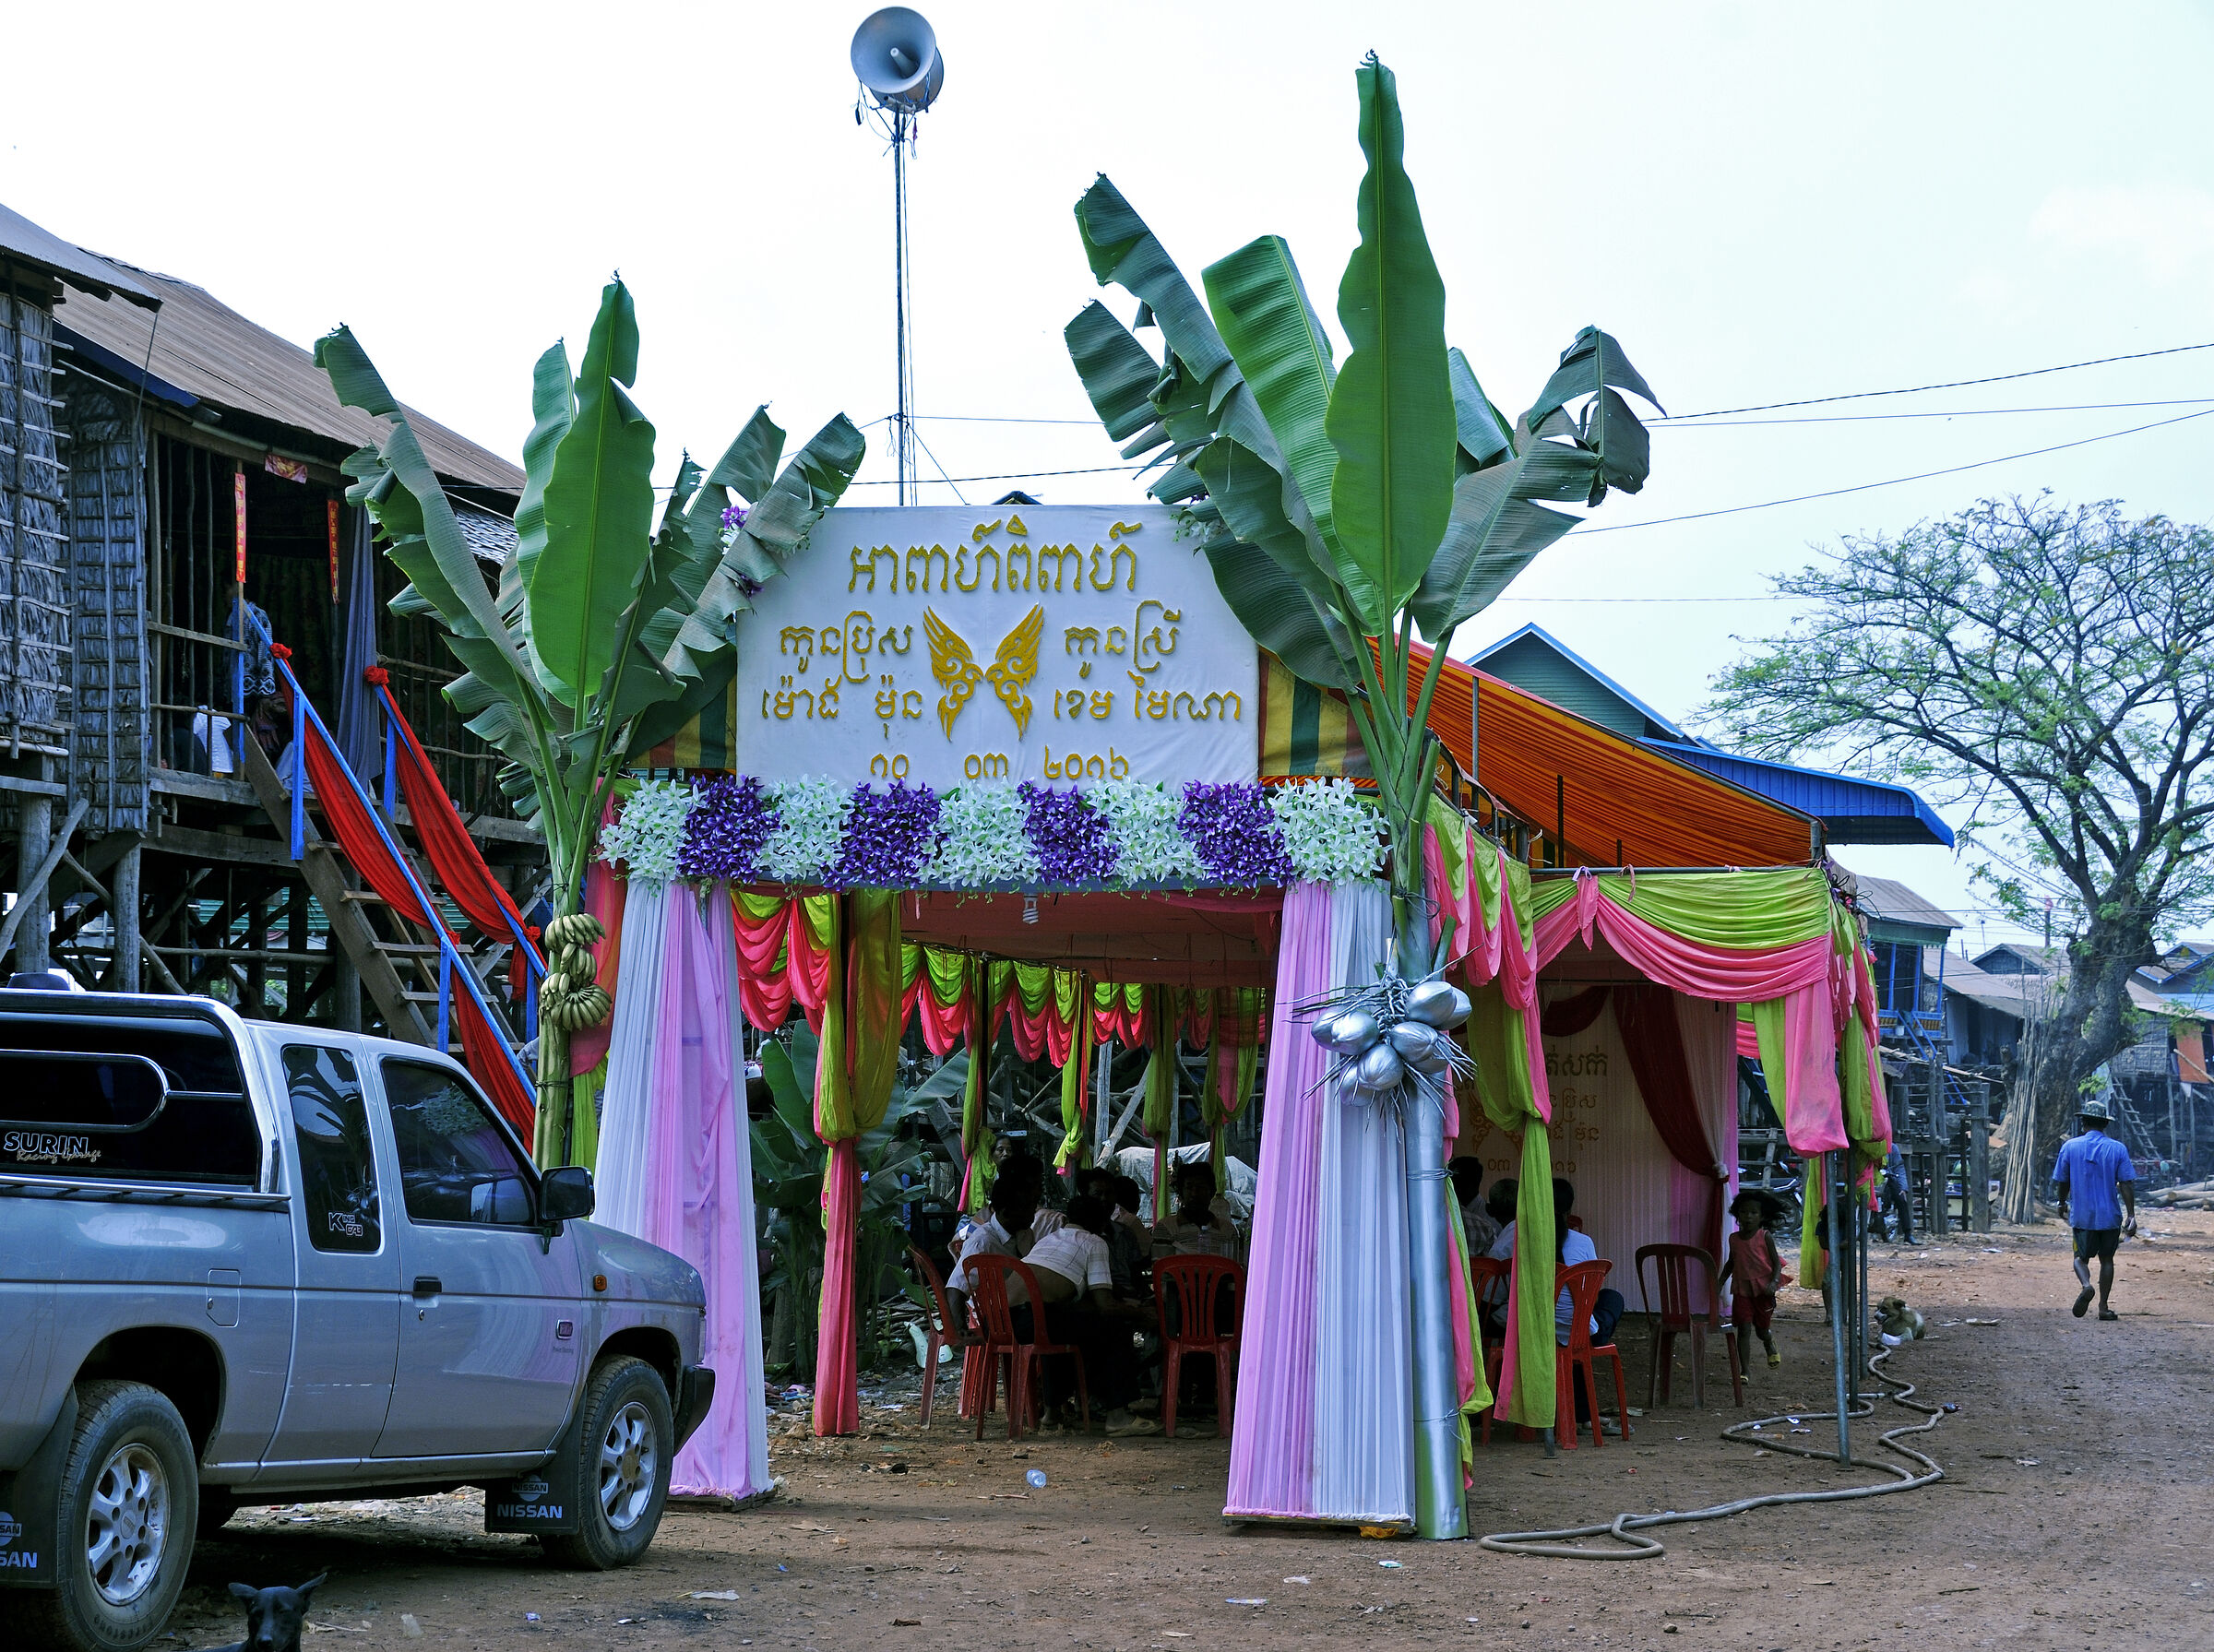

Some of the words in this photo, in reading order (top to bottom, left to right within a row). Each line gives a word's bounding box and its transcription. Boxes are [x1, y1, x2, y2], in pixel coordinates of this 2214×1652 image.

[848, 514, 1142, 593] អាពាហ៍ពិពាហ៍
[779, 610, 913, 683] កូនប្រុស
[1064, 600, 1181, 679] កូនស្រី
[1053, 689, 1115, 719] ខេម
[870, 753, 910, 779] ១០
[964, 752, 1009, 779] ០៣
[1043, 744, 1129, 779] ២០១៦
[4, 1131, 89, 1155] SURIN
[513, 1483, 547, 1492] NISSAN
[496, 1503, 563, 1519] NISSAN
[0, 1551, 38, 1568] SAN
